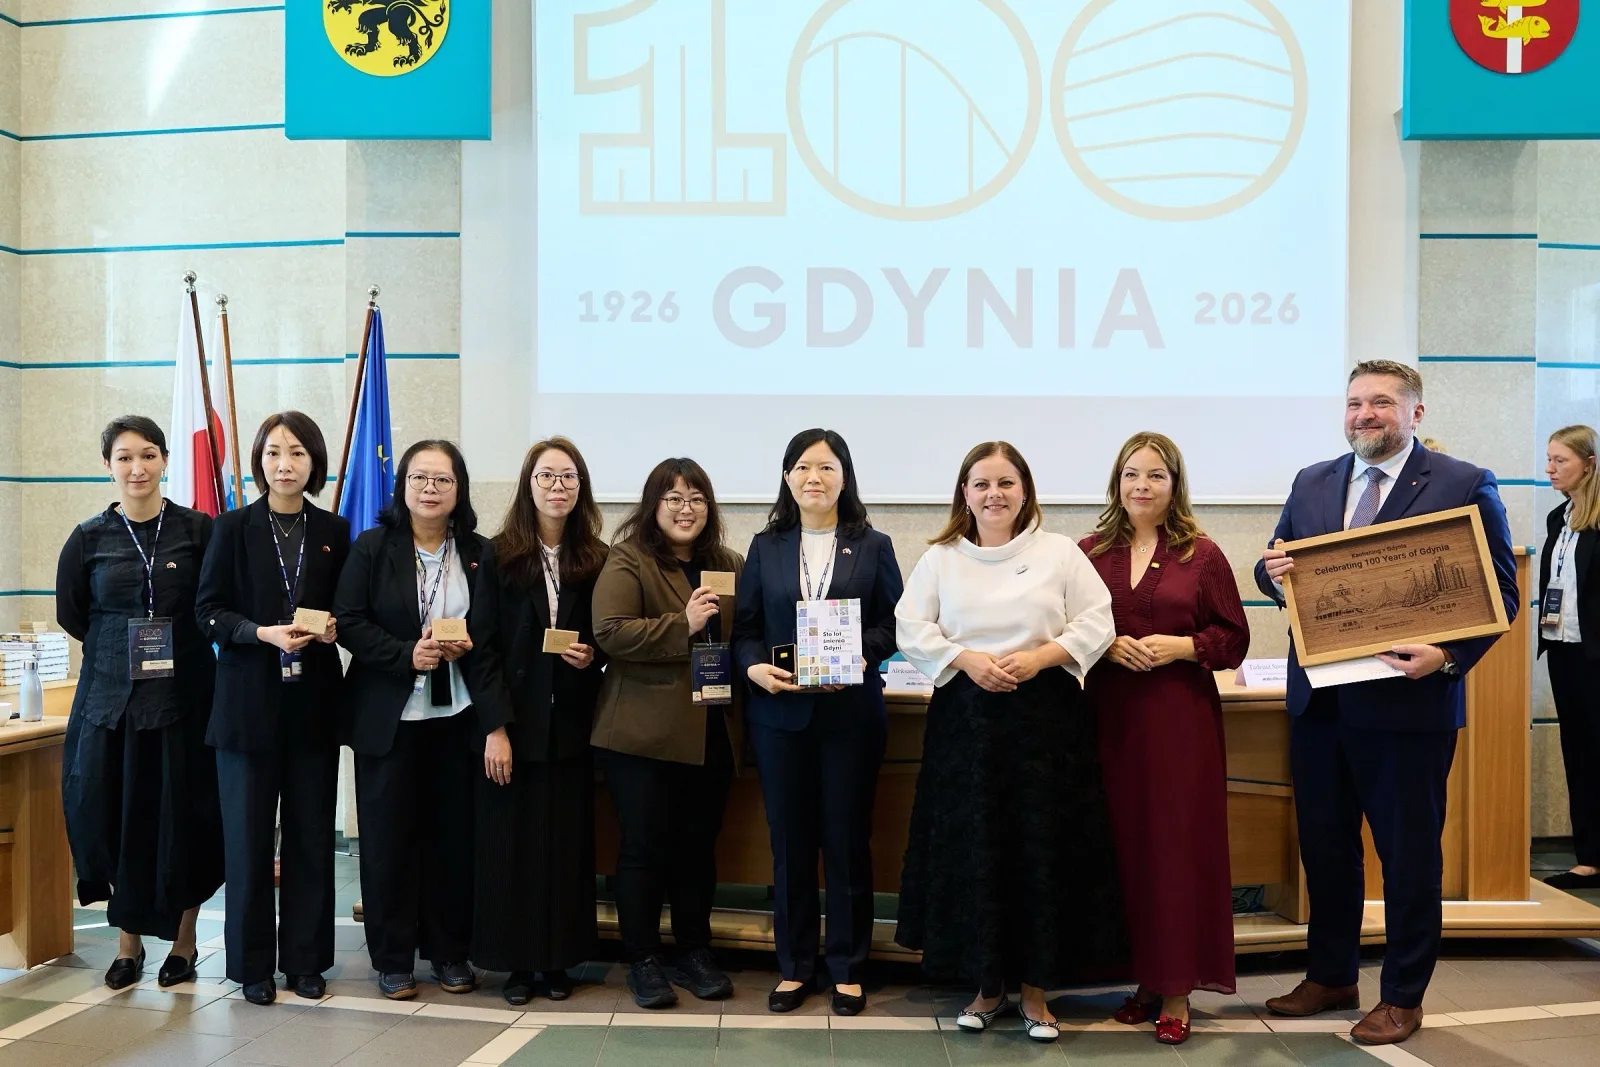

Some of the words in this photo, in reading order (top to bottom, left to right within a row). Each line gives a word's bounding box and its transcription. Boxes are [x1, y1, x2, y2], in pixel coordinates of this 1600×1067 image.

[573, 0, 1308, 221] 100
[577, 290, 680, 323] 1926
[711, 265, 1167, 349] GDYNIA
[1194, 292, 1301, 325] 2026
[1314, 561, 1363, 575] Celebrating
[1365, 557, 1380, 566] 100
[1382, 553, 1406, 563] Years
[1408, 549, 1418, 558] of
[1419, 543, 1450, 556] Gdynia
